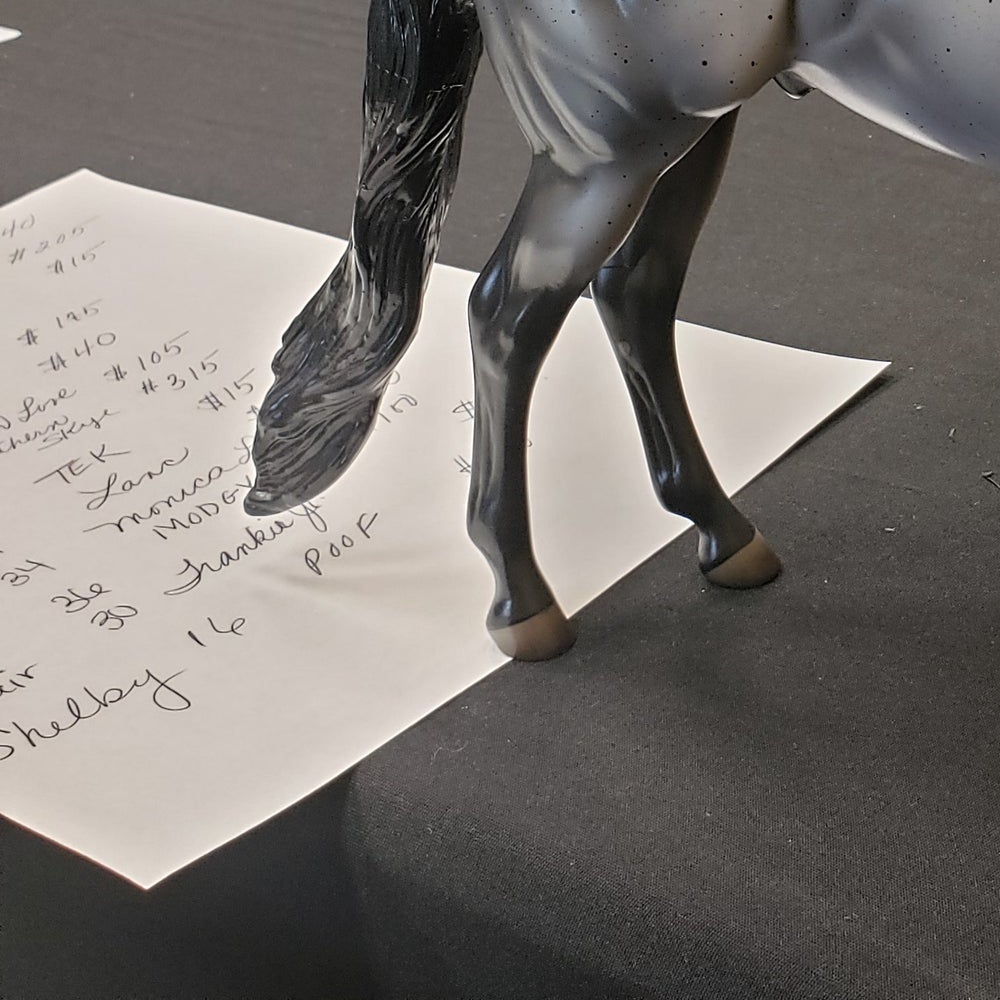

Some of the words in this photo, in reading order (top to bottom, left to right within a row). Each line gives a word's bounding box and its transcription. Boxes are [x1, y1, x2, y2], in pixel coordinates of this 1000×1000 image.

[33, 443, 132, 485] TEK
[304, 512, 379, 577] POOF
[90, 604, 139, 631] 30
